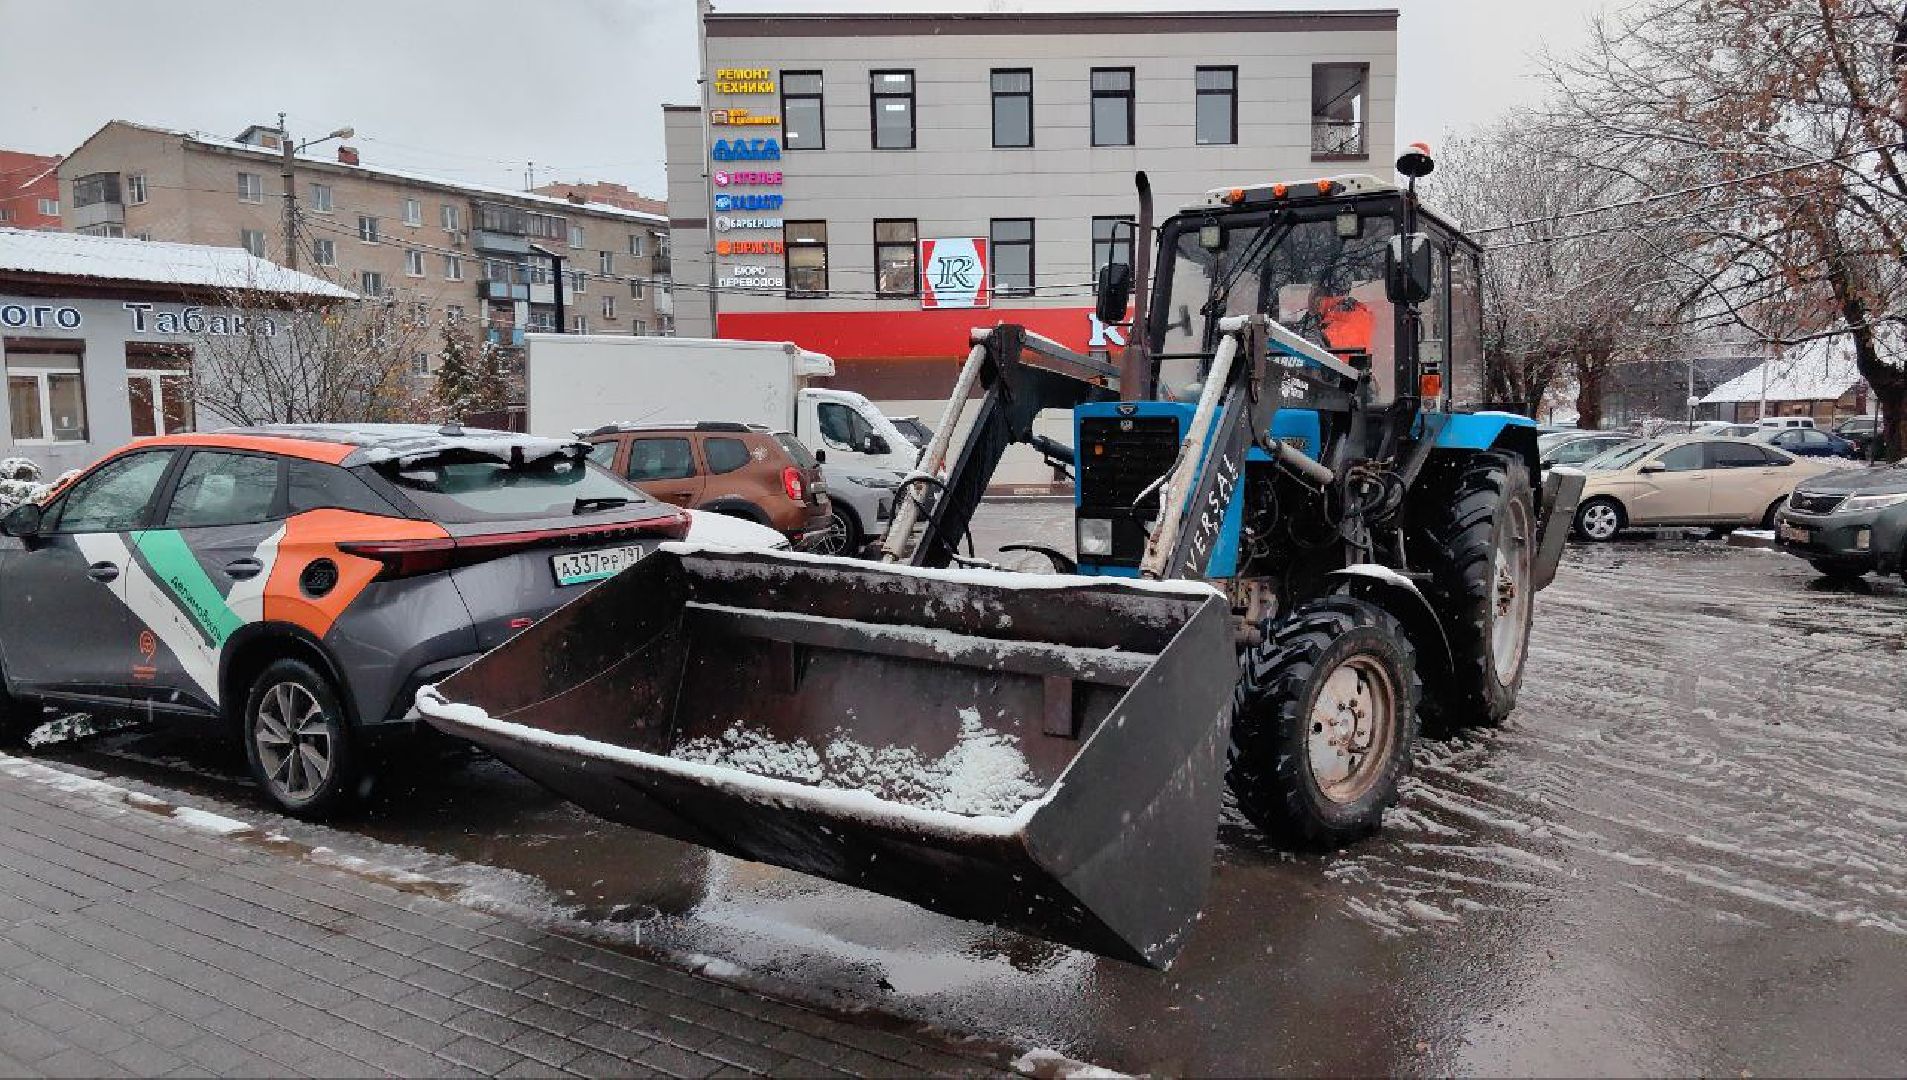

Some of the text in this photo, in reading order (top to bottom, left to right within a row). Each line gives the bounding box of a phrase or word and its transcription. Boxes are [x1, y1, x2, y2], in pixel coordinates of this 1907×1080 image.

[716, 68, 770, 79] РЕМОНТ
[714, 82, 775, 94] ТЕХНИКИ
[734, 171, 783, 185] АТЕЛЬЕ
[730, 219, 783, 228] БАРБЕРШОП
[734, 241, 784, 255] ЮРИСТЫ
[734, 266, 766, 276] БЮРО
[935, 255, 974, 289] R
[719, 278, 782, 288] ПЕРЕВОДОВ
[123, 302, 277, 336] Табака
[1181, 453, 1235, 580] VERSAL
